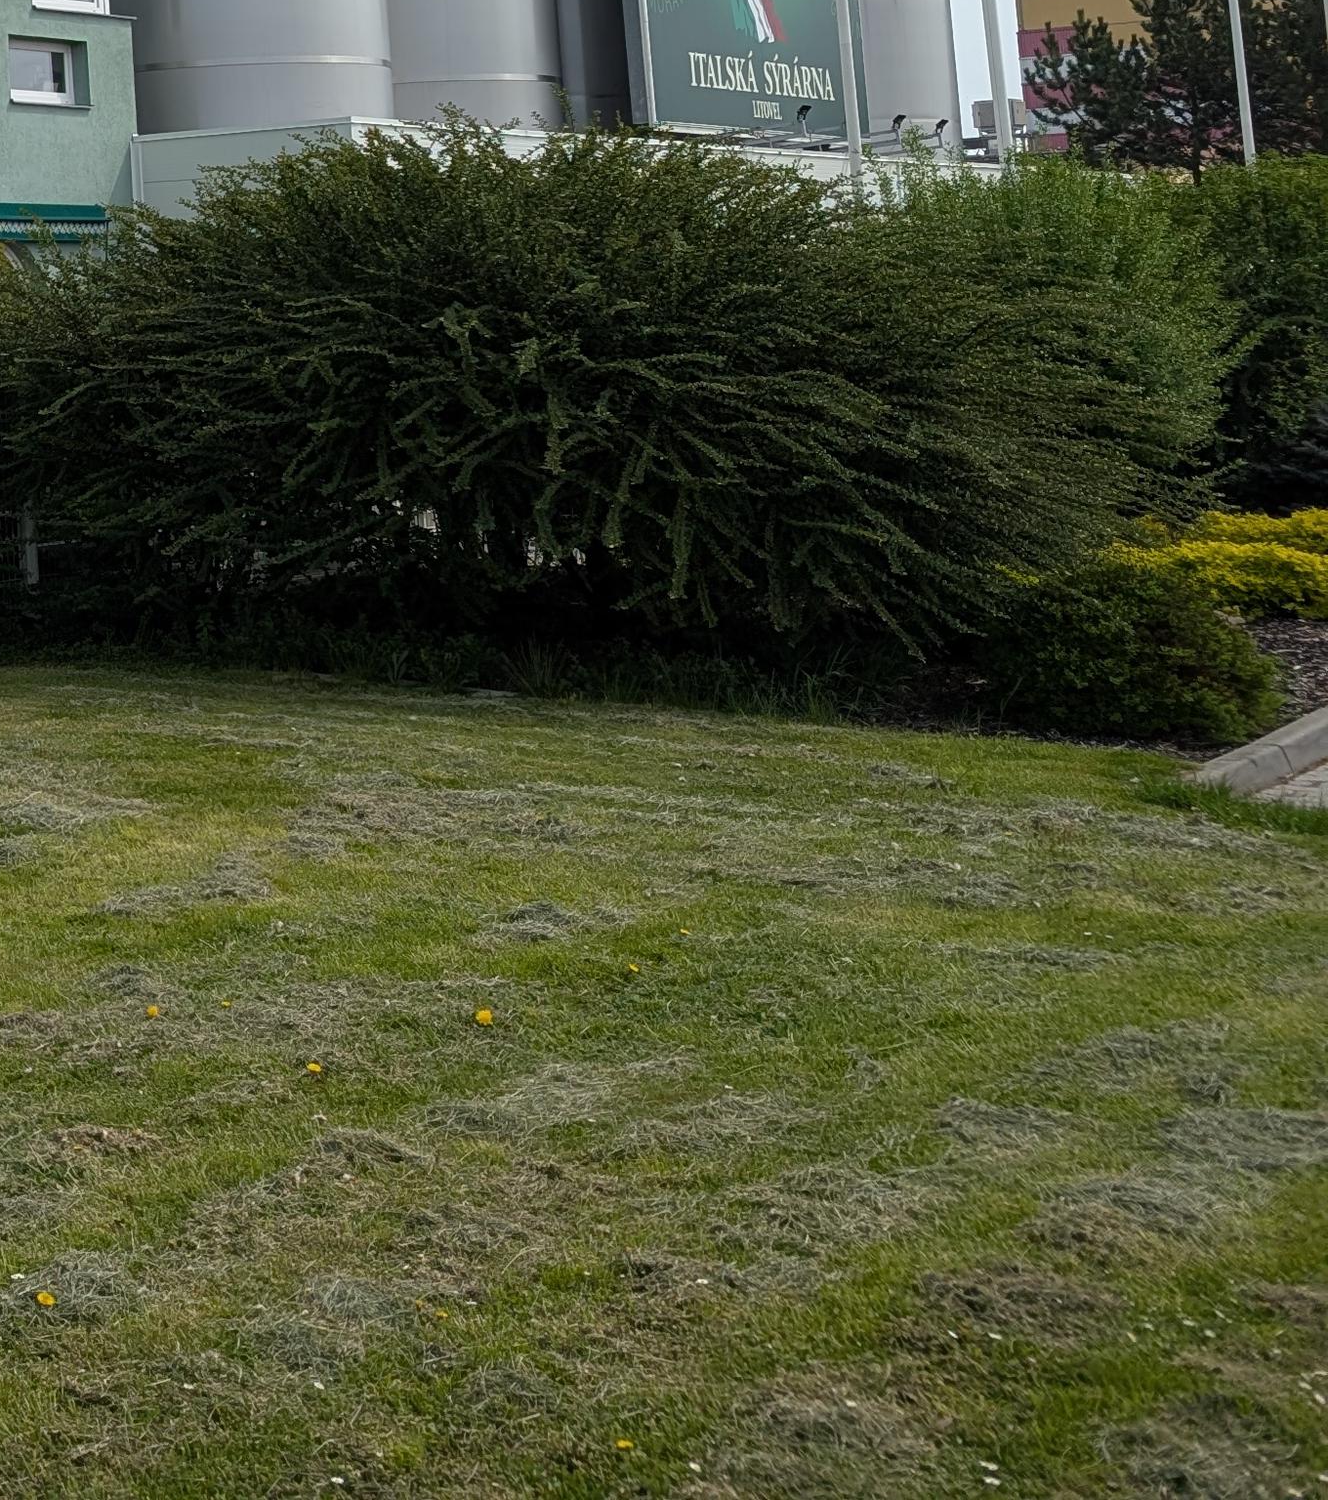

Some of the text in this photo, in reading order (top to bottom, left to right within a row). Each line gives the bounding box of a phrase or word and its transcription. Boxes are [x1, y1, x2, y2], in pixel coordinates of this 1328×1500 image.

[688, 50, 836, 101] ITALSKÁ SÝRÁRNA
[752, 100, 783, 121] LITOVEL
